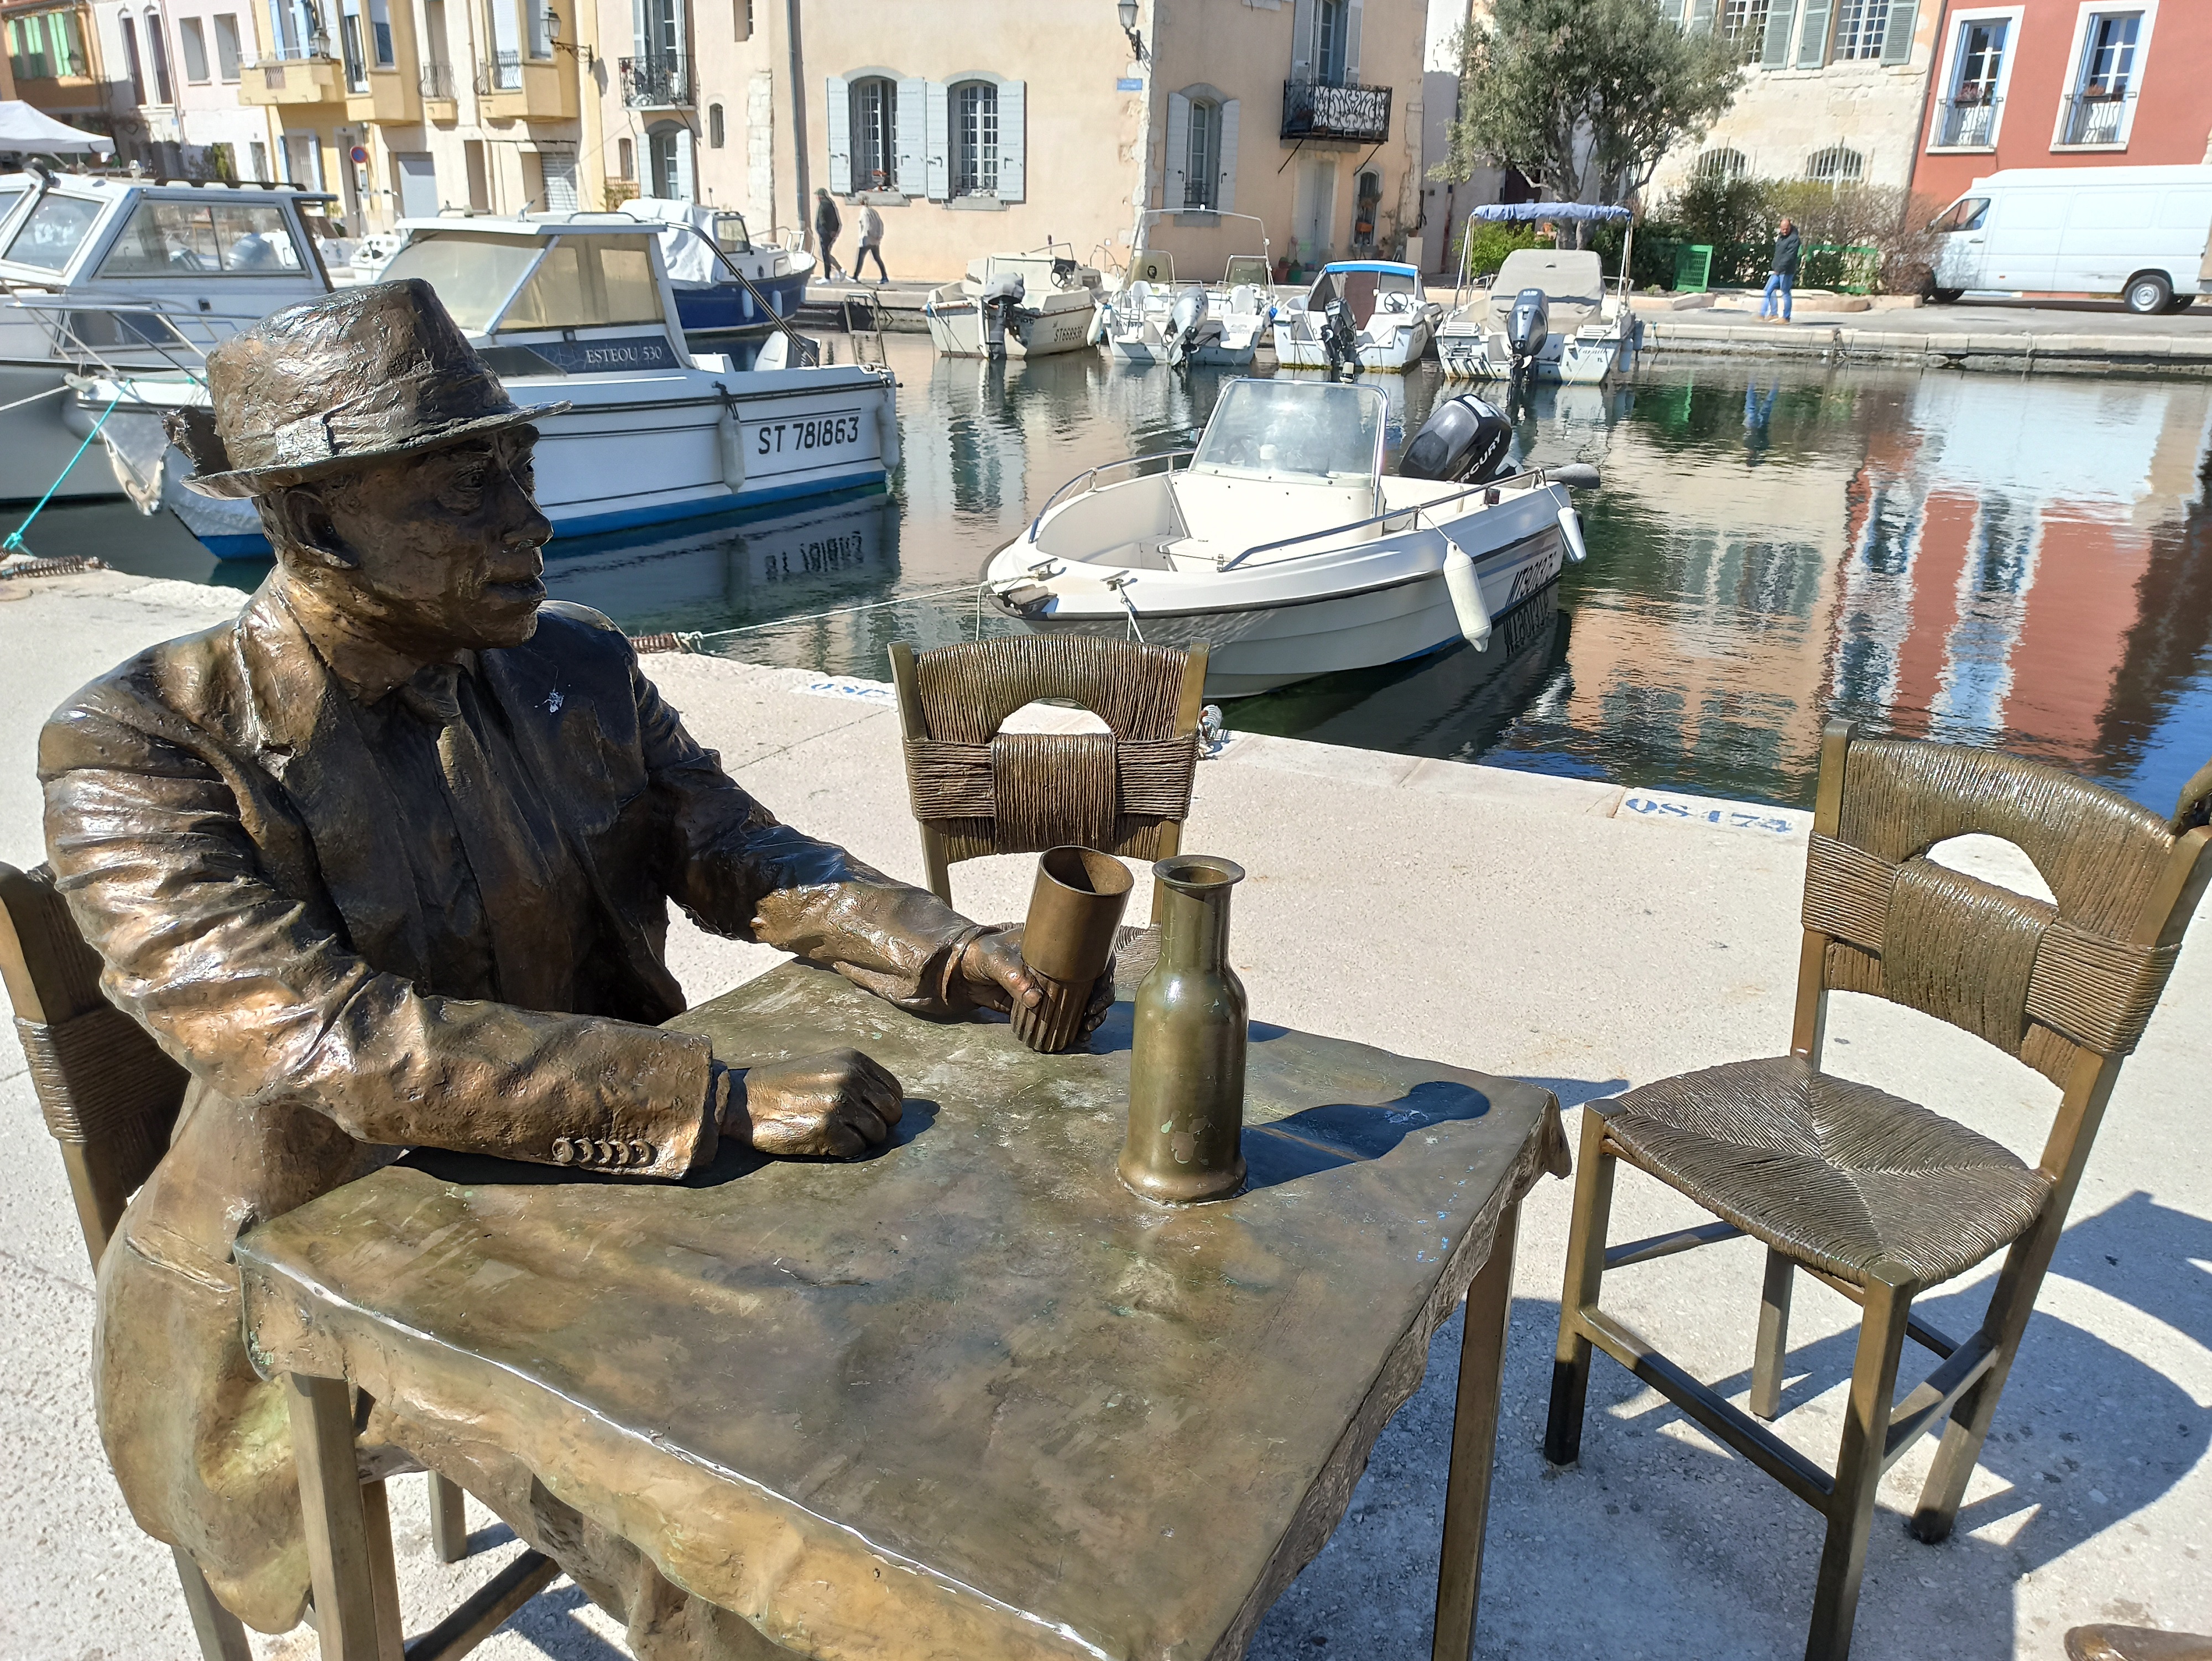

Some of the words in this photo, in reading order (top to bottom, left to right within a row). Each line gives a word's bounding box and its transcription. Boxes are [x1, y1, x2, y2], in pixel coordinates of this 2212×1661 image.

[585, 347, 638, 363] ESTEOU
[643, 346, 662, 360] 530
[758, 425, 786, 454] ST
[793, 416, 859, 450] 781863
